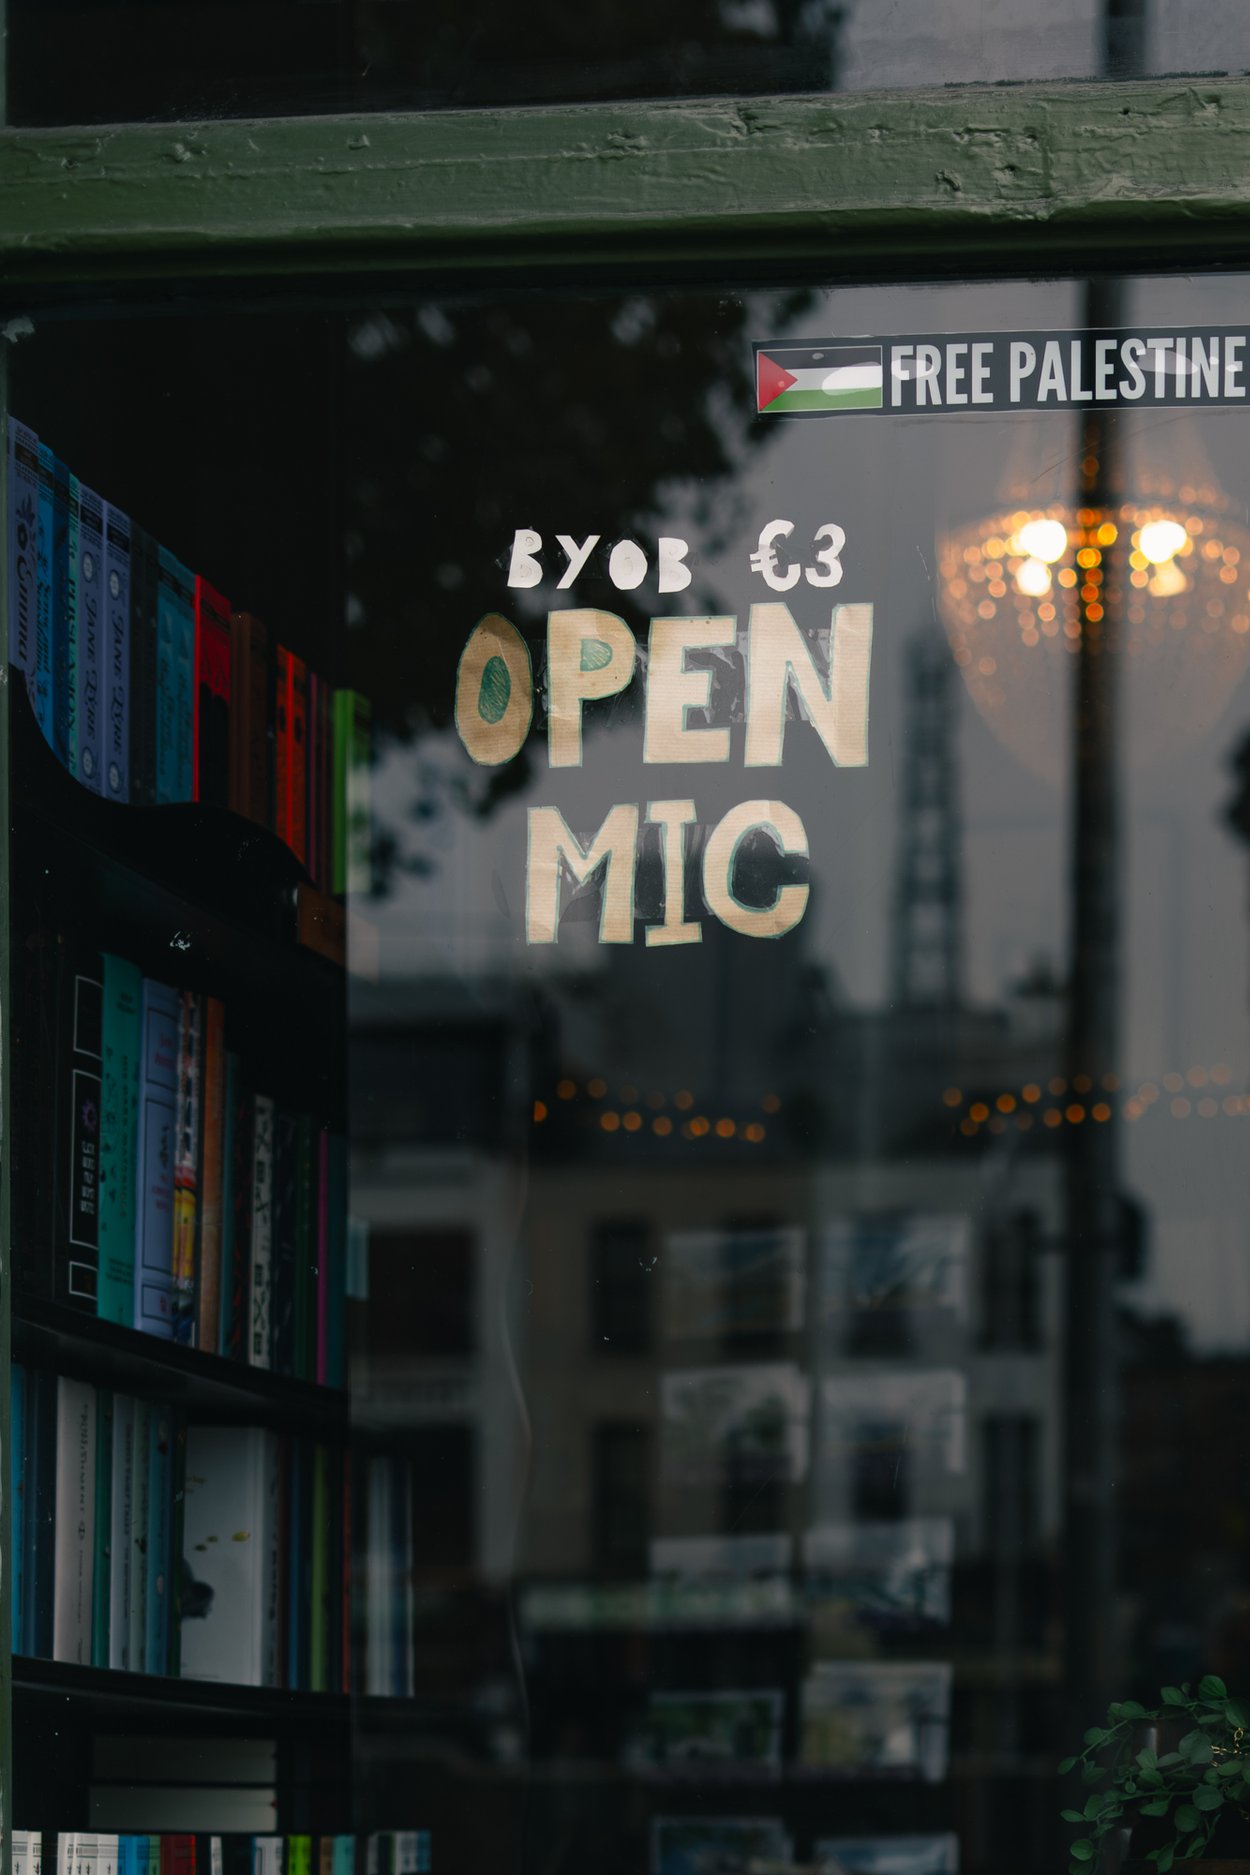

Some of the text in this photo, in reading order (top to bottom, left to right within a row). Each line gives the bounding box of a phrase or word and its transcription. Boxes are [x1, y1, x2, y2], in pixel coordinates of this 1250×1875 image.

[891, 337, 1247, 406] FREE PALESTINE
[16, 555, 33, 663] Emma
[507, 519, 845, 593] BYOB €3
[84, 592, 98, 740] JANE EYRE
[111, 610, 125, 756] JANE EYRE
[454, 602, 874, 768] OPEN
[525, 799, 810, 946] MIC
